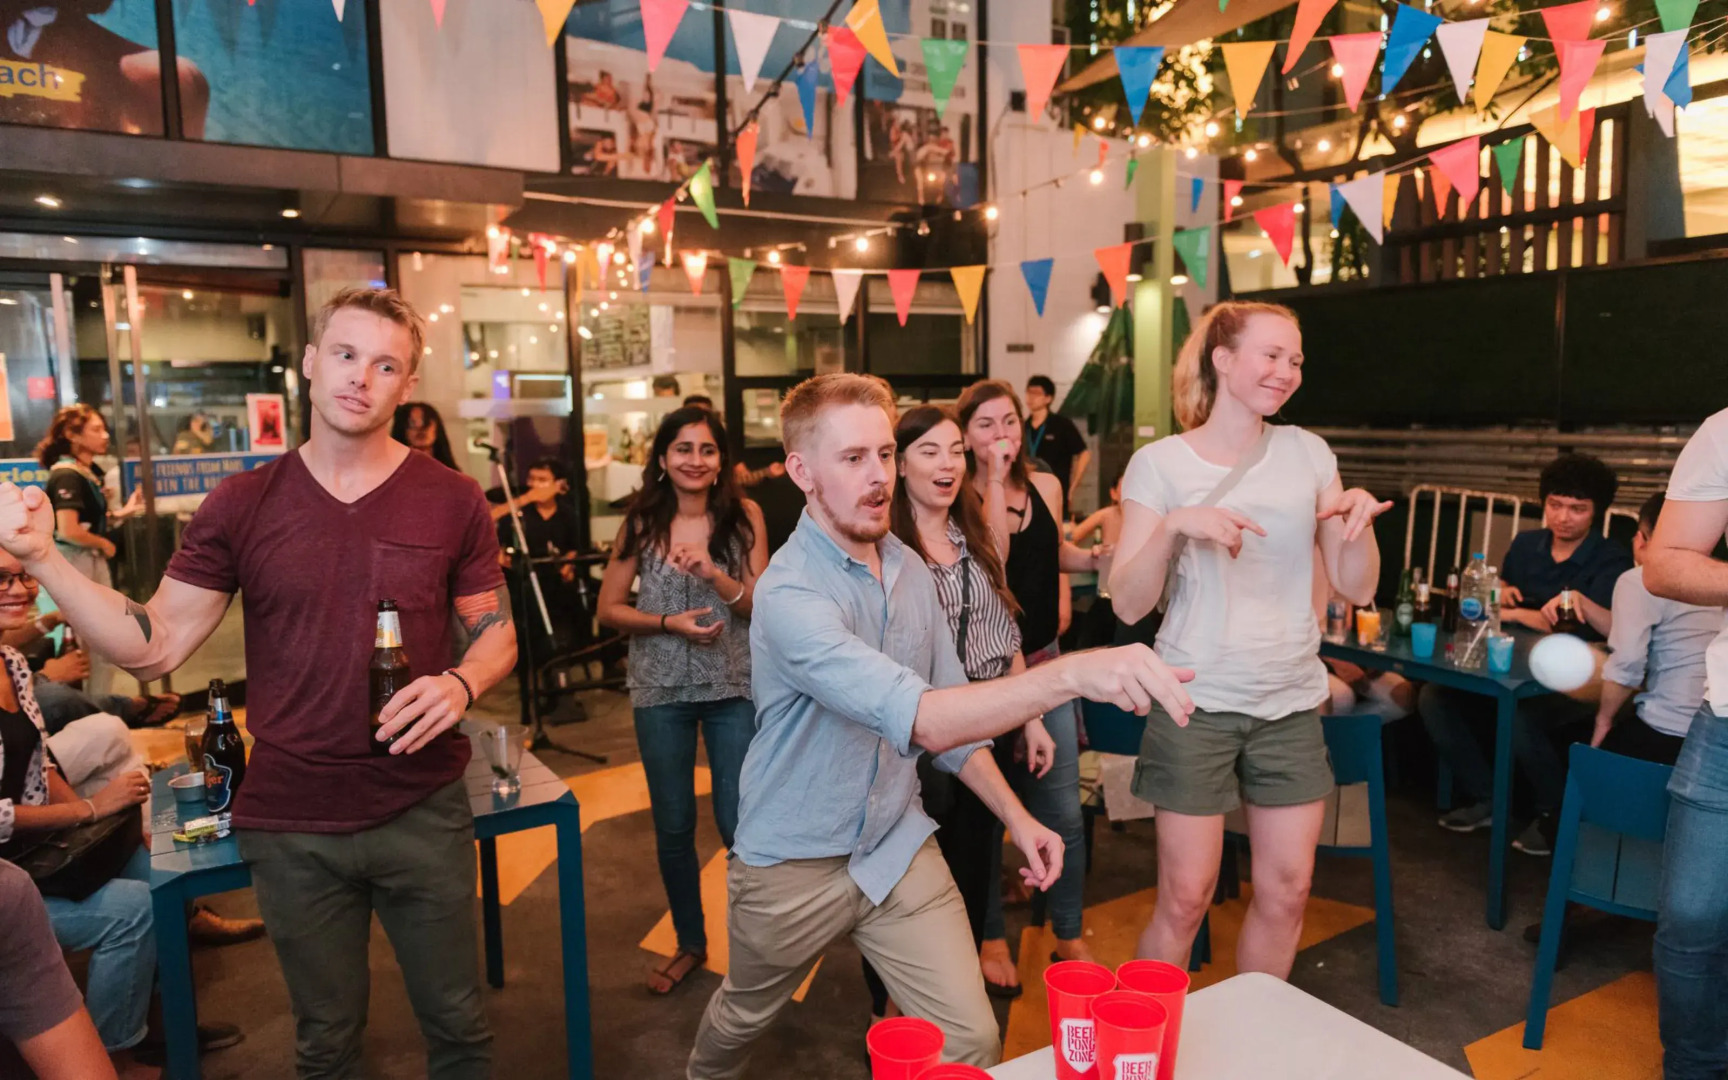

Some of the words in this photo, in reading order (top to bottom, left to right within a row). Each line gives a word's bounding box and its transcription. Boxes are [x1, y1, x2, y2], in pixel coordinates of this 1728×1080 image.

[1068, 1039, 1095, 1051] PONG
[1069, 1050, 1095, 1062] ZONE
[1122, 1061, 1152, 1075] BEER
